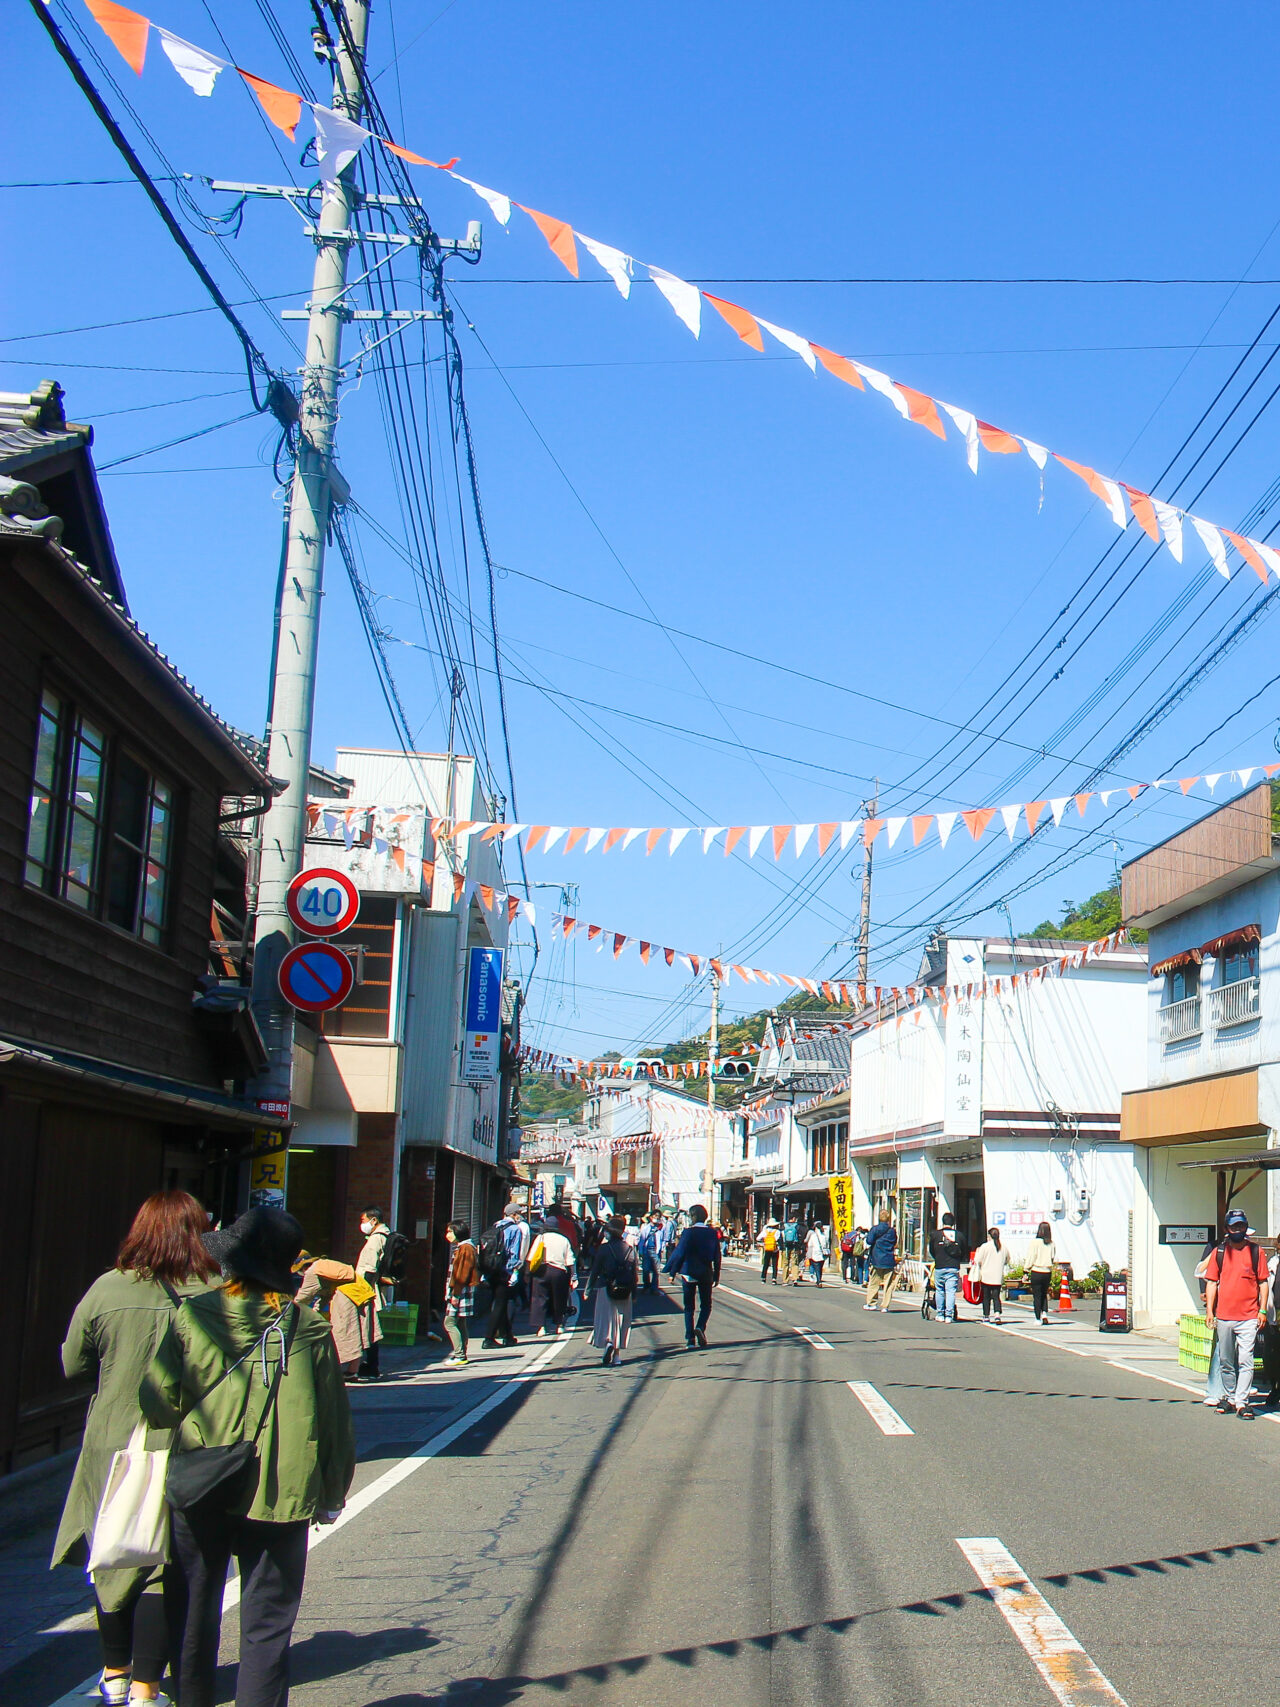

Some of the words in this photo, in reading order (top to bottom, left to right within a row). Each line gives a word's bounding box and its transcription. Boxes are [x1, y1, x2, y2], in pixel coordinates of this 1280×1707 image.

[302, 886, 342, 917] 40
[477, 953, 493, 1022] Panasonic
[956, 1002, 972, 1112] 勝木陶仙堂
[994, 1213, 1005, 1225] P
